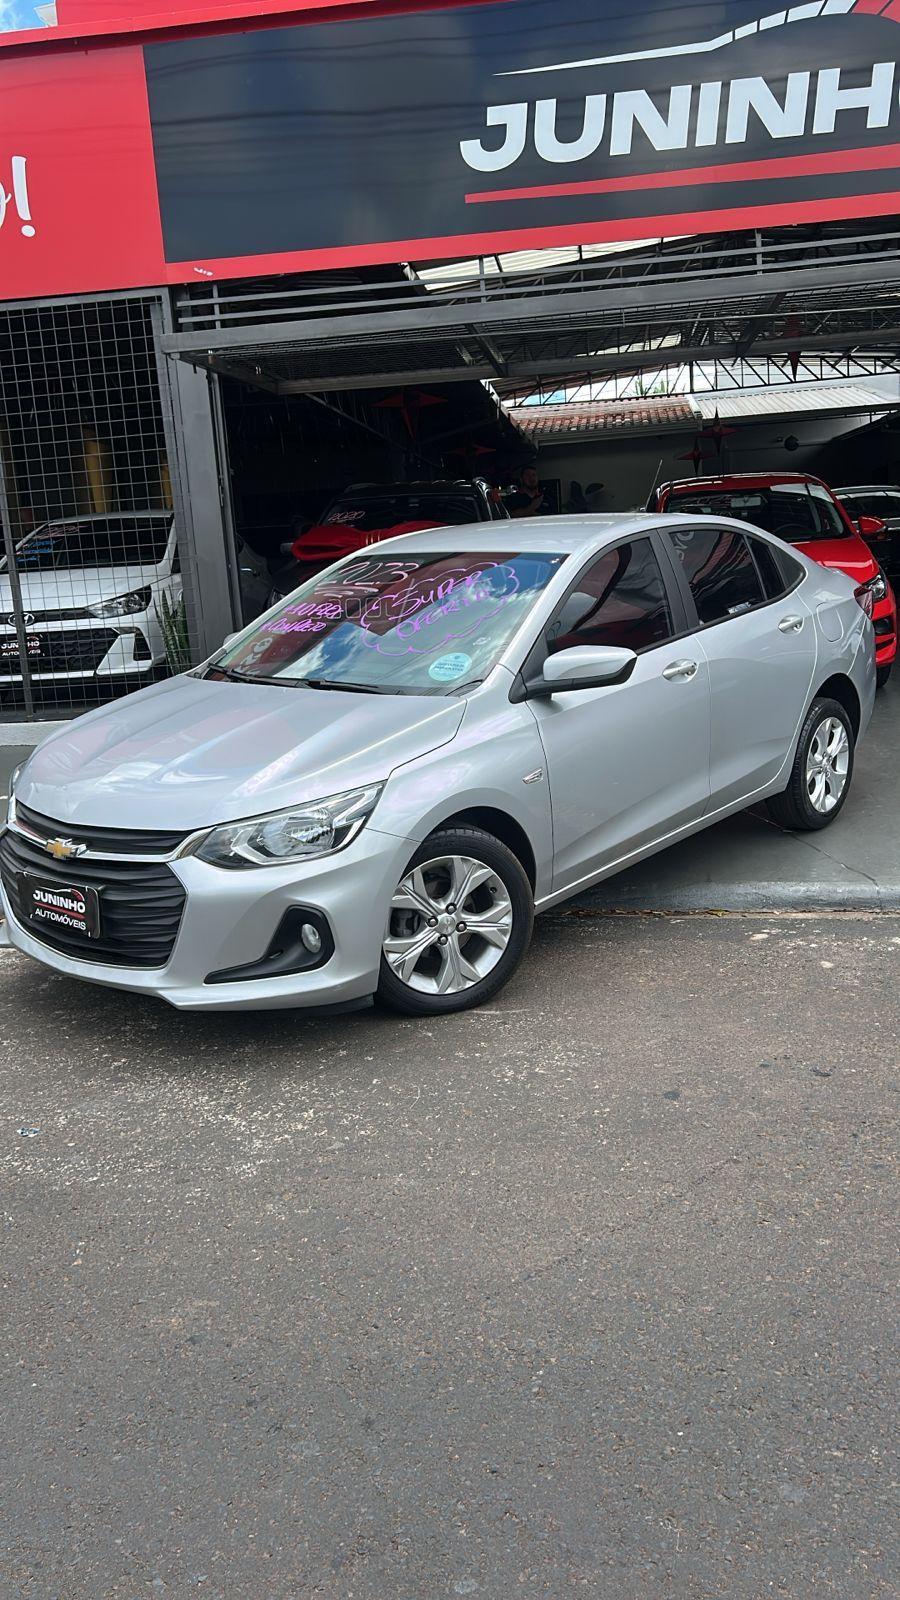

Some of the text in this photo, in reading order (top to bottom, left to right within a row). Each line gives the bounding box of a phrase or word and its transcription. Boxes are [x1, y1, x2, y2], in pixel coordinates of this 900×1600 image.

[459, 62, 900, 172] JUNINH
[1, 640, 40, 650] JUNHO
[33, 890, 86, 913] JUNINHO
[35, 908, 86, 931] AUTOMÓVEIS
